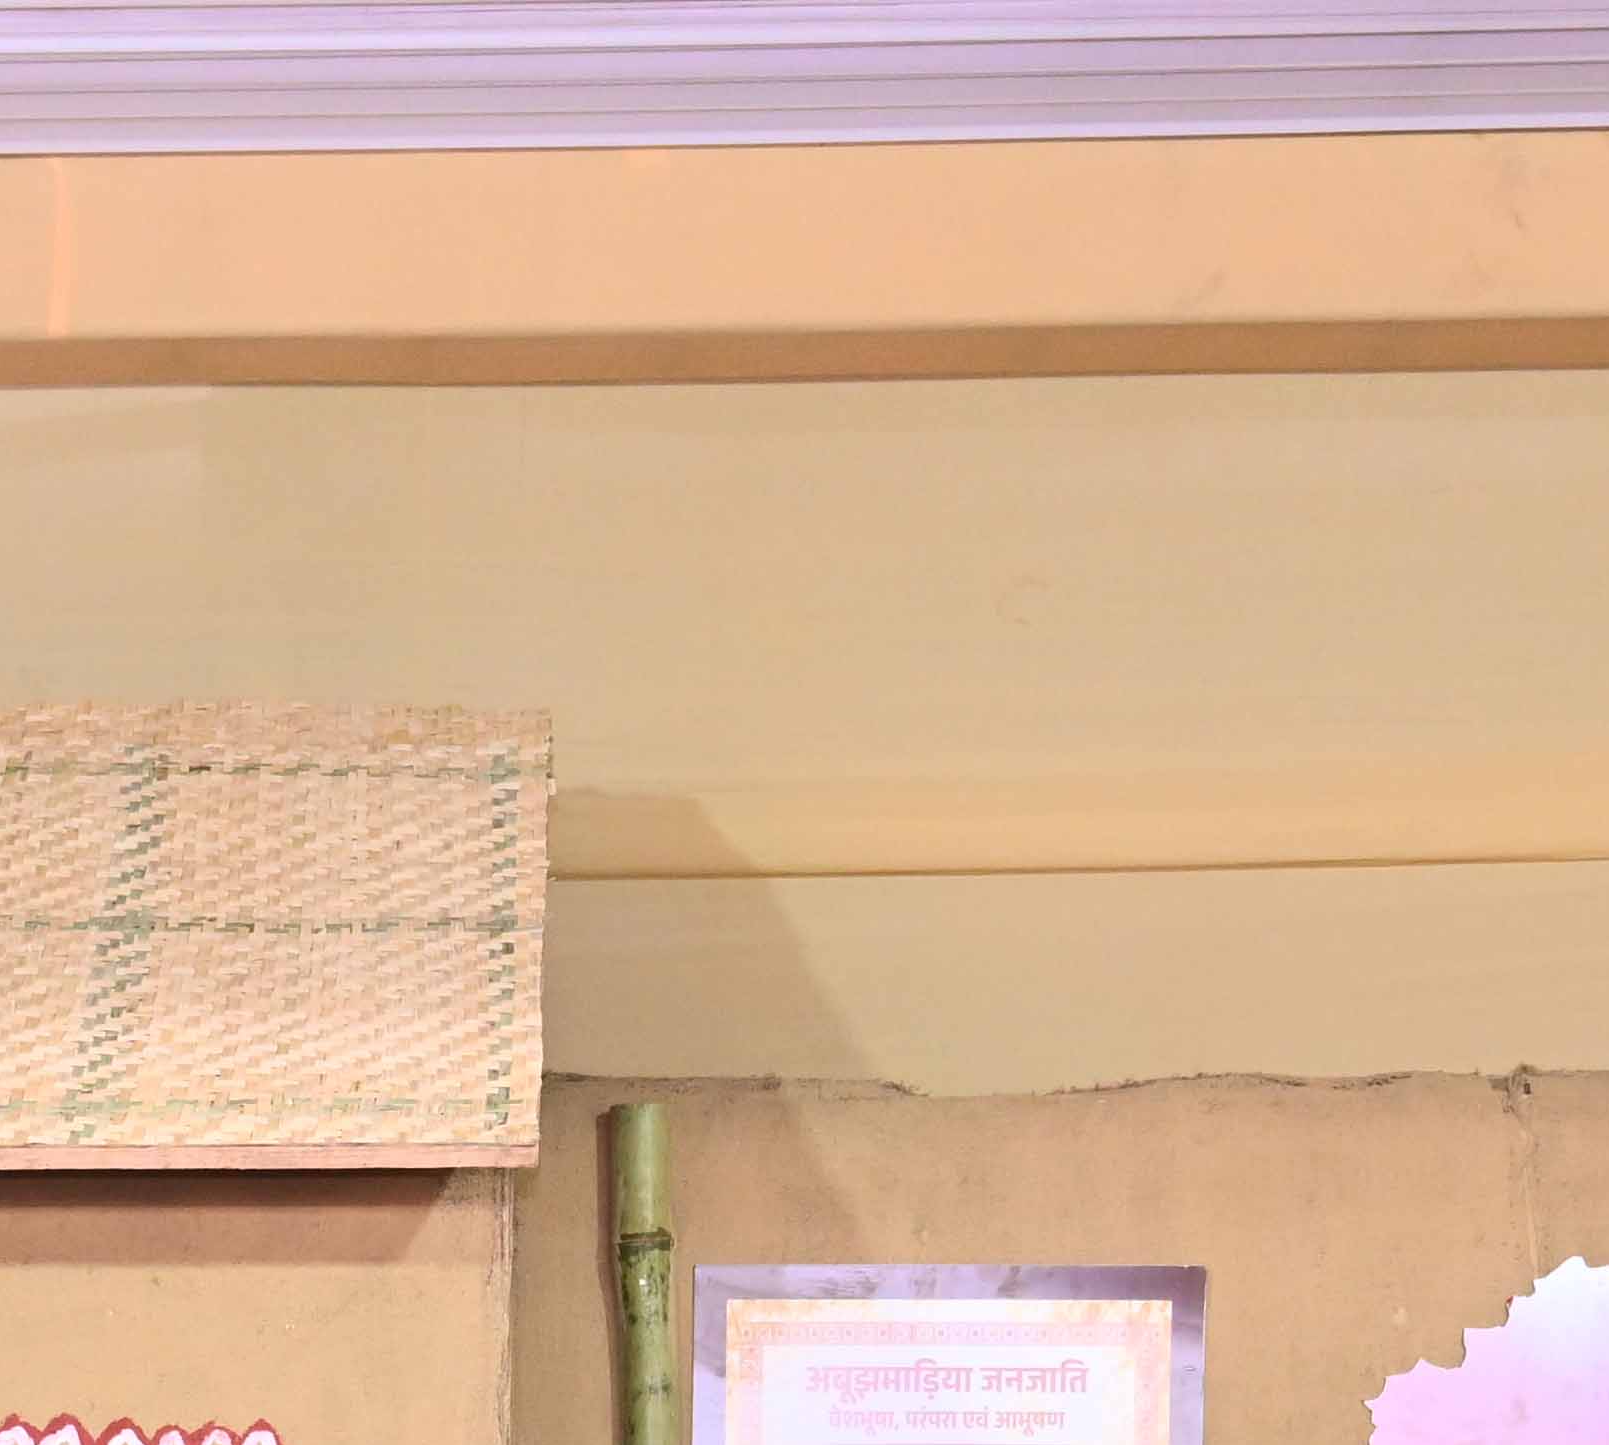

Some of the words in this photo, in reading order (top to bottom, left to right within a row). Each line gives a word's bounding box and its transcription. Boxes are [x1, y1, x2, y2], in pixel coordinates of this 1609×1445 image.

[981, 1360, 1089, 1393] जनजाति
[829, 1406, 899, 1435] वेशभूषा,
[905, 1407, 955, 1429] परंपरा
[963, 1407, 987, 1429] एवं
[996, 1411, 1065, 1436] आभूषण
